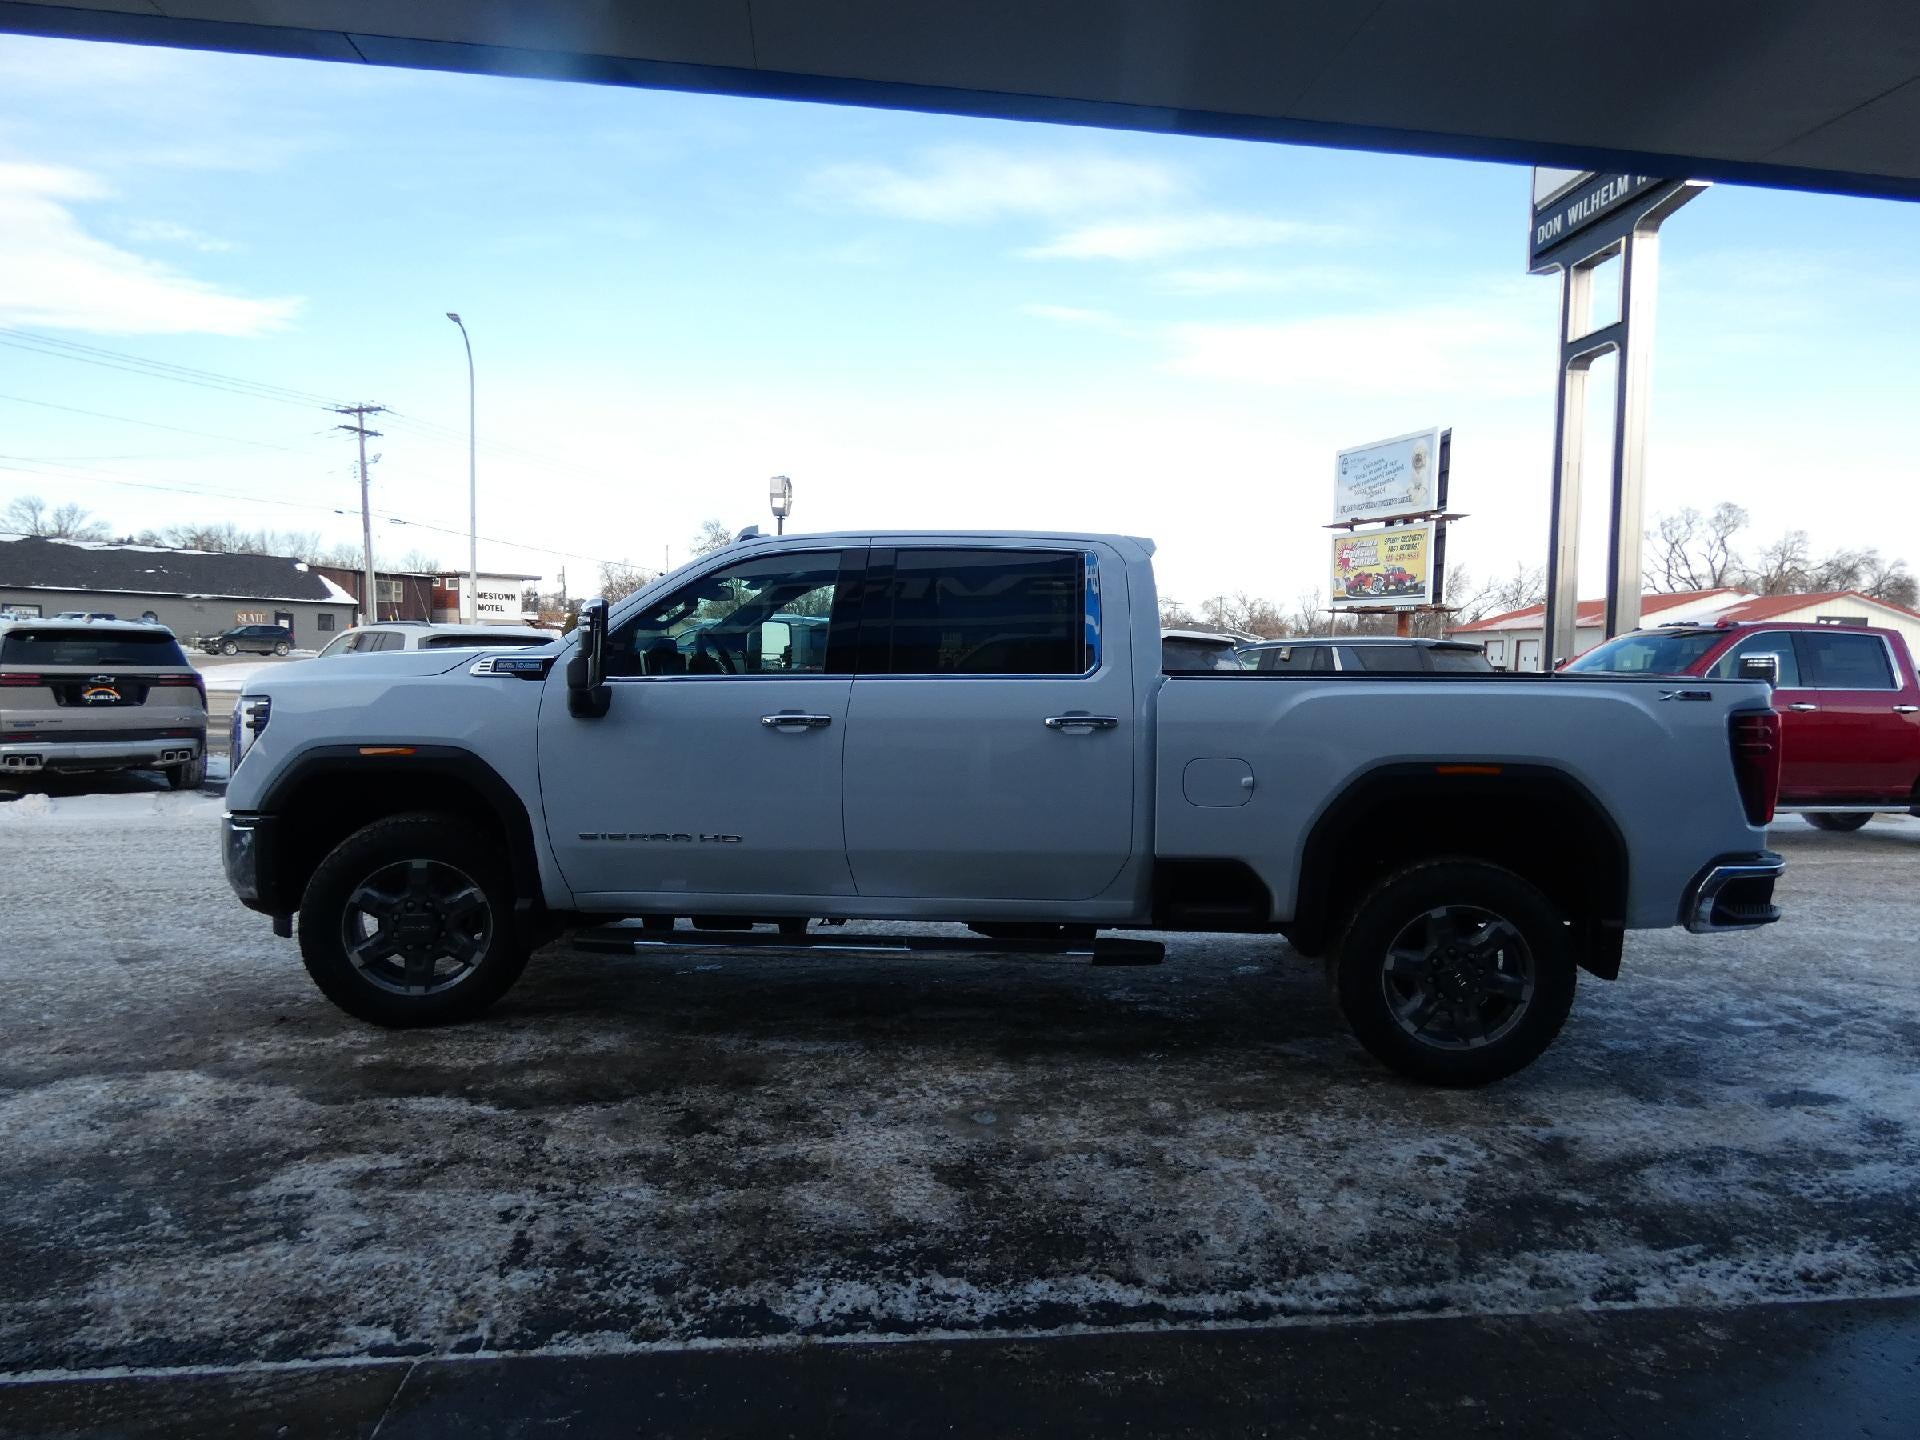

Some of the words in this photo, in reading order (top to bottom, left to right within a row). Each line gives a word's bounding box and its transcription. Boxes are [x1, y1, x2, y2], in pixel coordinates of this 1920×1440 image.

[1537, 213, 1562, 245] DON
[1567, 174, 1630, 227] WILHELM
[467, 591, 516, 601] MESTOWN
[477, 604, 505, 612] MOTEL
[578, 832, 693, 841] SIERRA
[699, 833, 744, 843] HD
